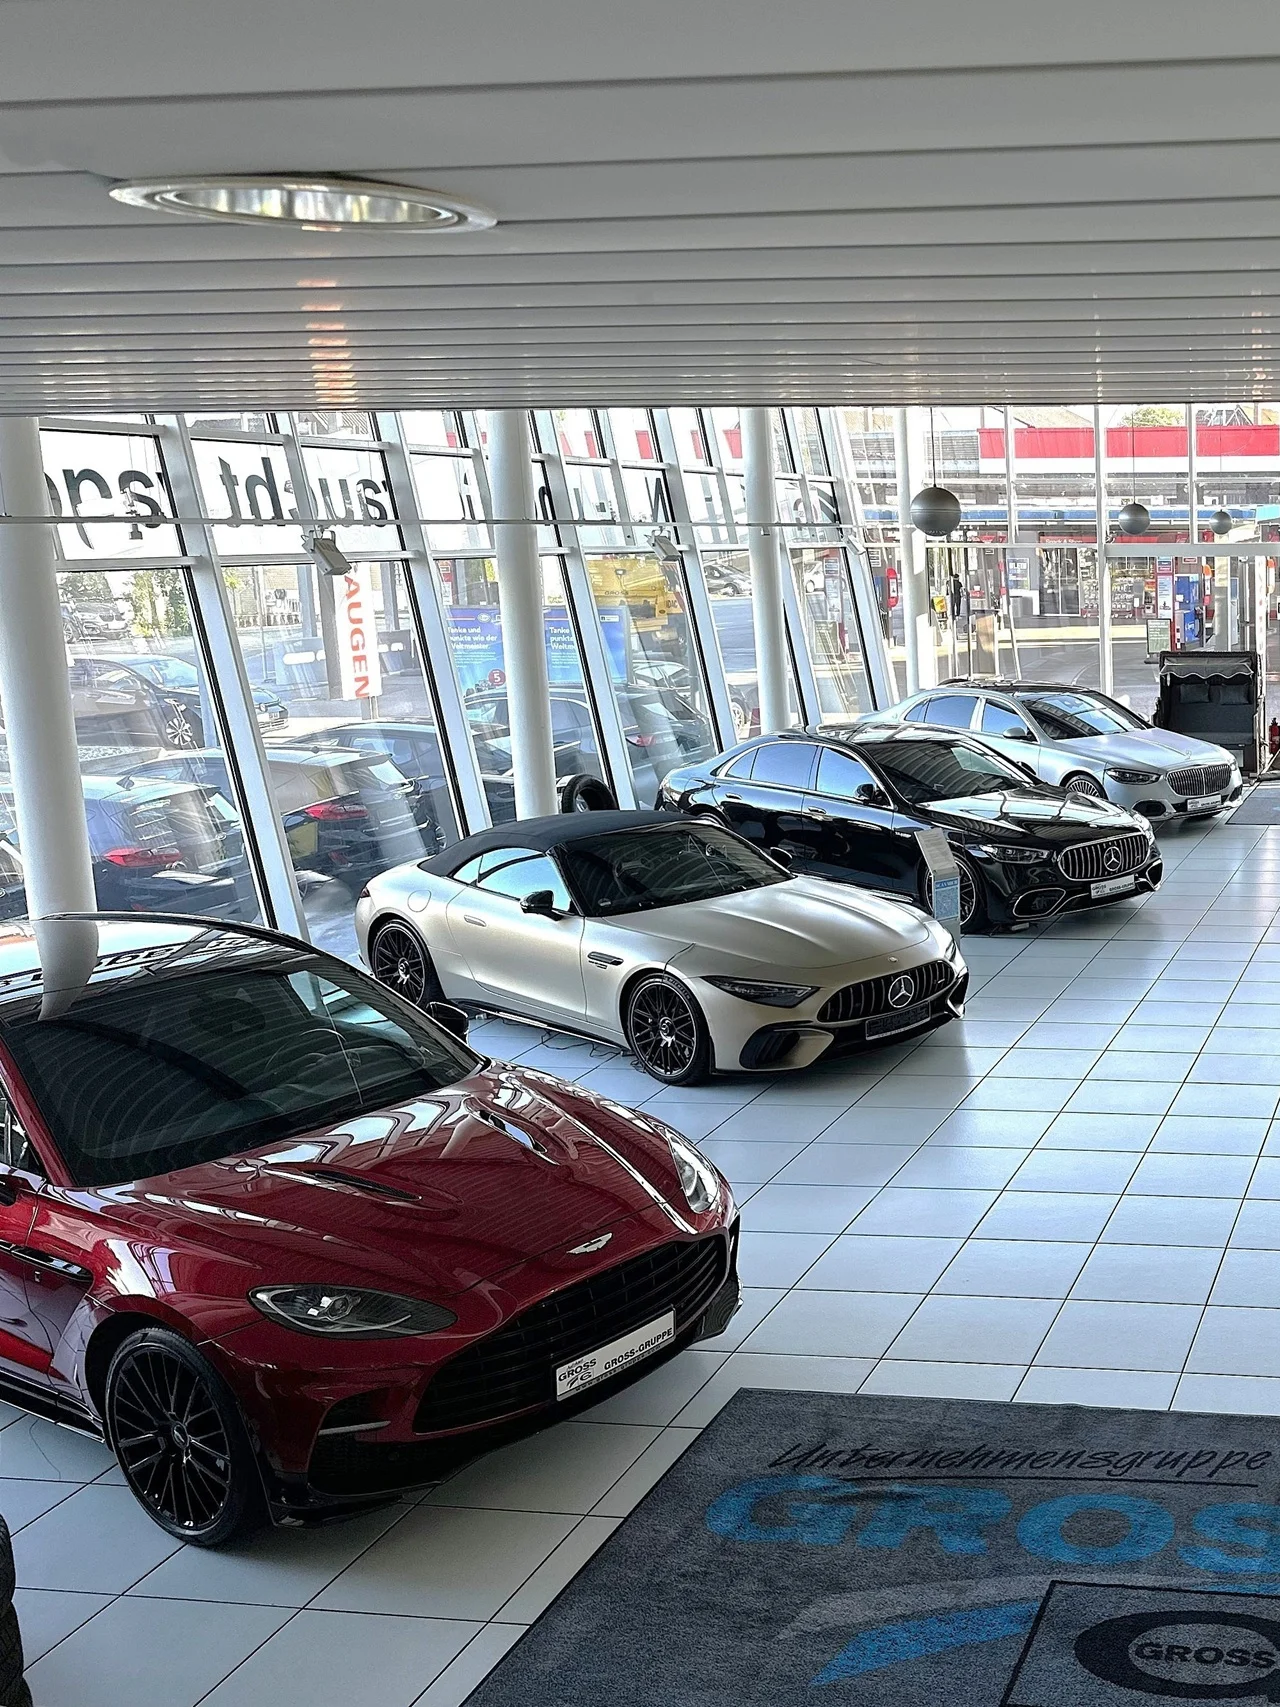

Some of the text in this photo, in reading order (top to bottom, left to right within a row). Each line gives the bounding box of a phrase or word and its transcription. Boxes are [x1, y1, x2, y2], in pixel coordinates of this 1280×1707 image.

[344, 566, 370, 699] AUGEN
[493, 672, 501, 683] 5
[604, 1327, 673, 1370] GROSS-GRUPPE
[558, 1358, 597, 1382] GROSS
[768, 1442, 1272, 1477] Unternehmensgruppe
[1134, 1641, 1276, 1669] GROSS
